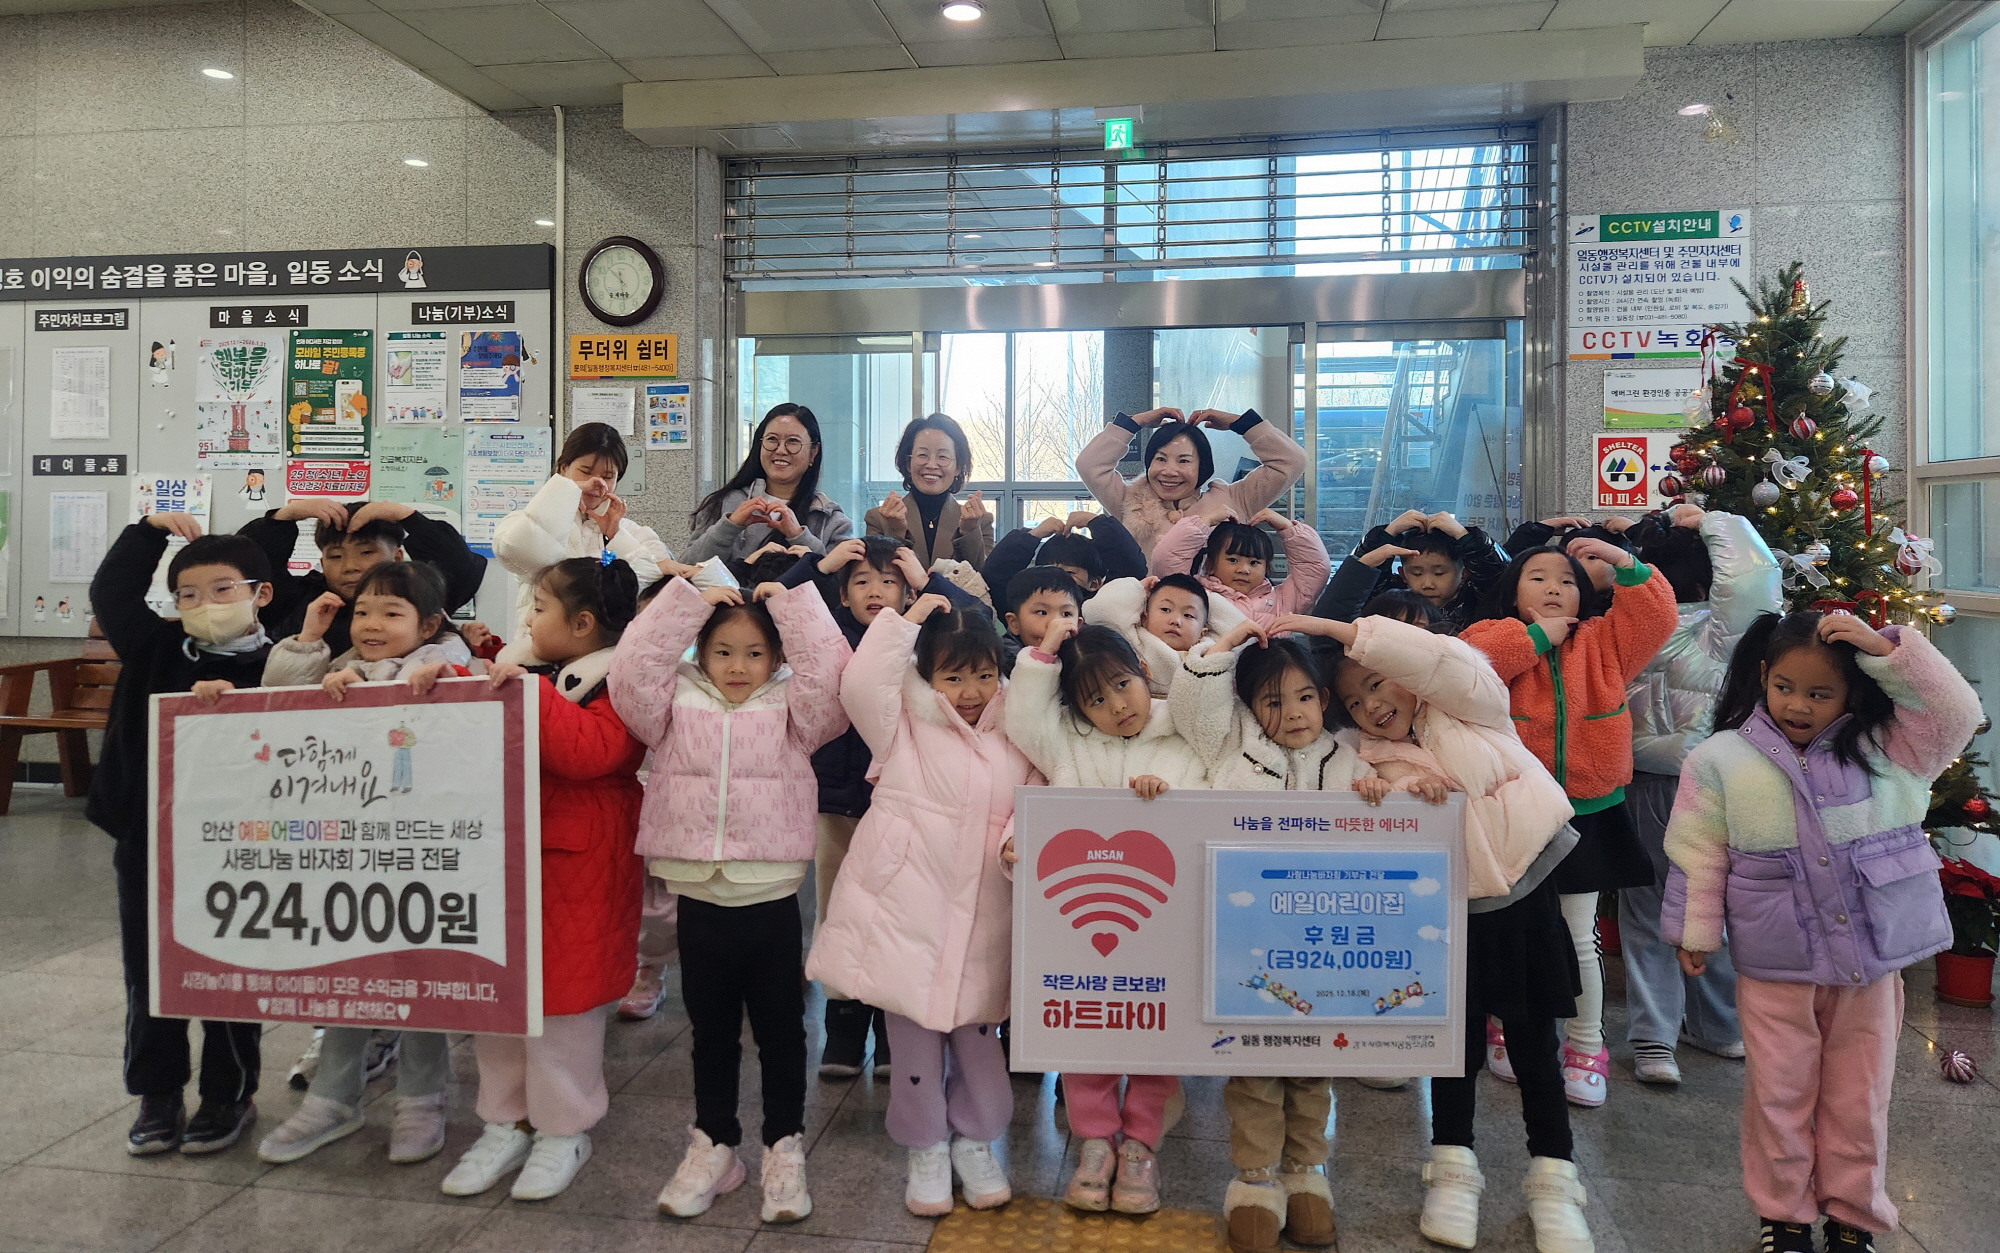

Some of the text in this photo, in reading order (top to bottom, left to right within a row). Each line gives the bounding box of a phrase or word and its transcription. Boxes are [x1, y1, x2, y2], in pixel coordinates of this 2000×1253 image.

[1608, 218, 1711, 234] CCTV설치안내
[1577, 244, 1742, 261] 일동행정복지센터 및 주민자치센터
[1579, 257, 1740, 272] 시설물 관리를 위해 건물 내부에
[31, 266, 94, 290] 이익의
[100, 264, 167, 289] 숨결을
[173, 263, 218, 288] 품은
[287, 260, 332, 285] 일동
[338, 258, 383, 282] 소식
[1579, 271, 1720, 285] CCTV가 설치되어 있습니다.
[38, 311, 125, 328] 주민자치프로그램
[418, 304, 508, 322] 나눔(기부)소식
[1583, 331, 1651, 350] CCTV
[214, 347, 267, 367] 행복을
[295, 347, 366, 358] 모바일 주민등록증
[579, 339, 668, 360] 무더위 쉼터
[219, 367, 259, 380] 더하는
[294, 359, 340, 375] 하나로 끝!
[1602, 441, 1644, 455] SHELTER
[290, 470, 303, 479] 25
[346, 470, 366, 480] 노인
[156, 480, 187, 497] 일상
[290, 482, 322, 491] 정신건강
[756, 723, 776, 736] NY
[734, 737, 756, 749] NY
[276, 735, 357, 772] 다함께
[270, 760, 387, 808] 이겨내요
[753, 783, 772, 795] NY
[202, 820, 483, 842] 안산 예일어린이집과 함께 만드는 세상
[1233, 816, 1419, 833] 나눔을 전파하는 따뜻한 에너지
[222, 848, 460, 873] 사랑나눔 바자회 기부금 전달
[1087, 850, 1124, 861] ANSAN
[1270, 891, 1405, 916] 예일어린이집
[205, 880, 478, 946] 924,000원
[1267, 950, 1412, 970] (금924,000원)
[246, 974, 273, 993] 통해
[276, 976, 330, 994] 아이들이
[332, 977, 359, 996] 모은
[363, 979, 418, 998] 수익금을
[422, 980, 498, 1002] 기부합니다.
[1043, 974, 1166, 993] 작은사랑 큰보람!
[1043, 999, 1166, 1031] 하트파이
[1241, 1035, 1321, 1048] 일동 행정복지센터
